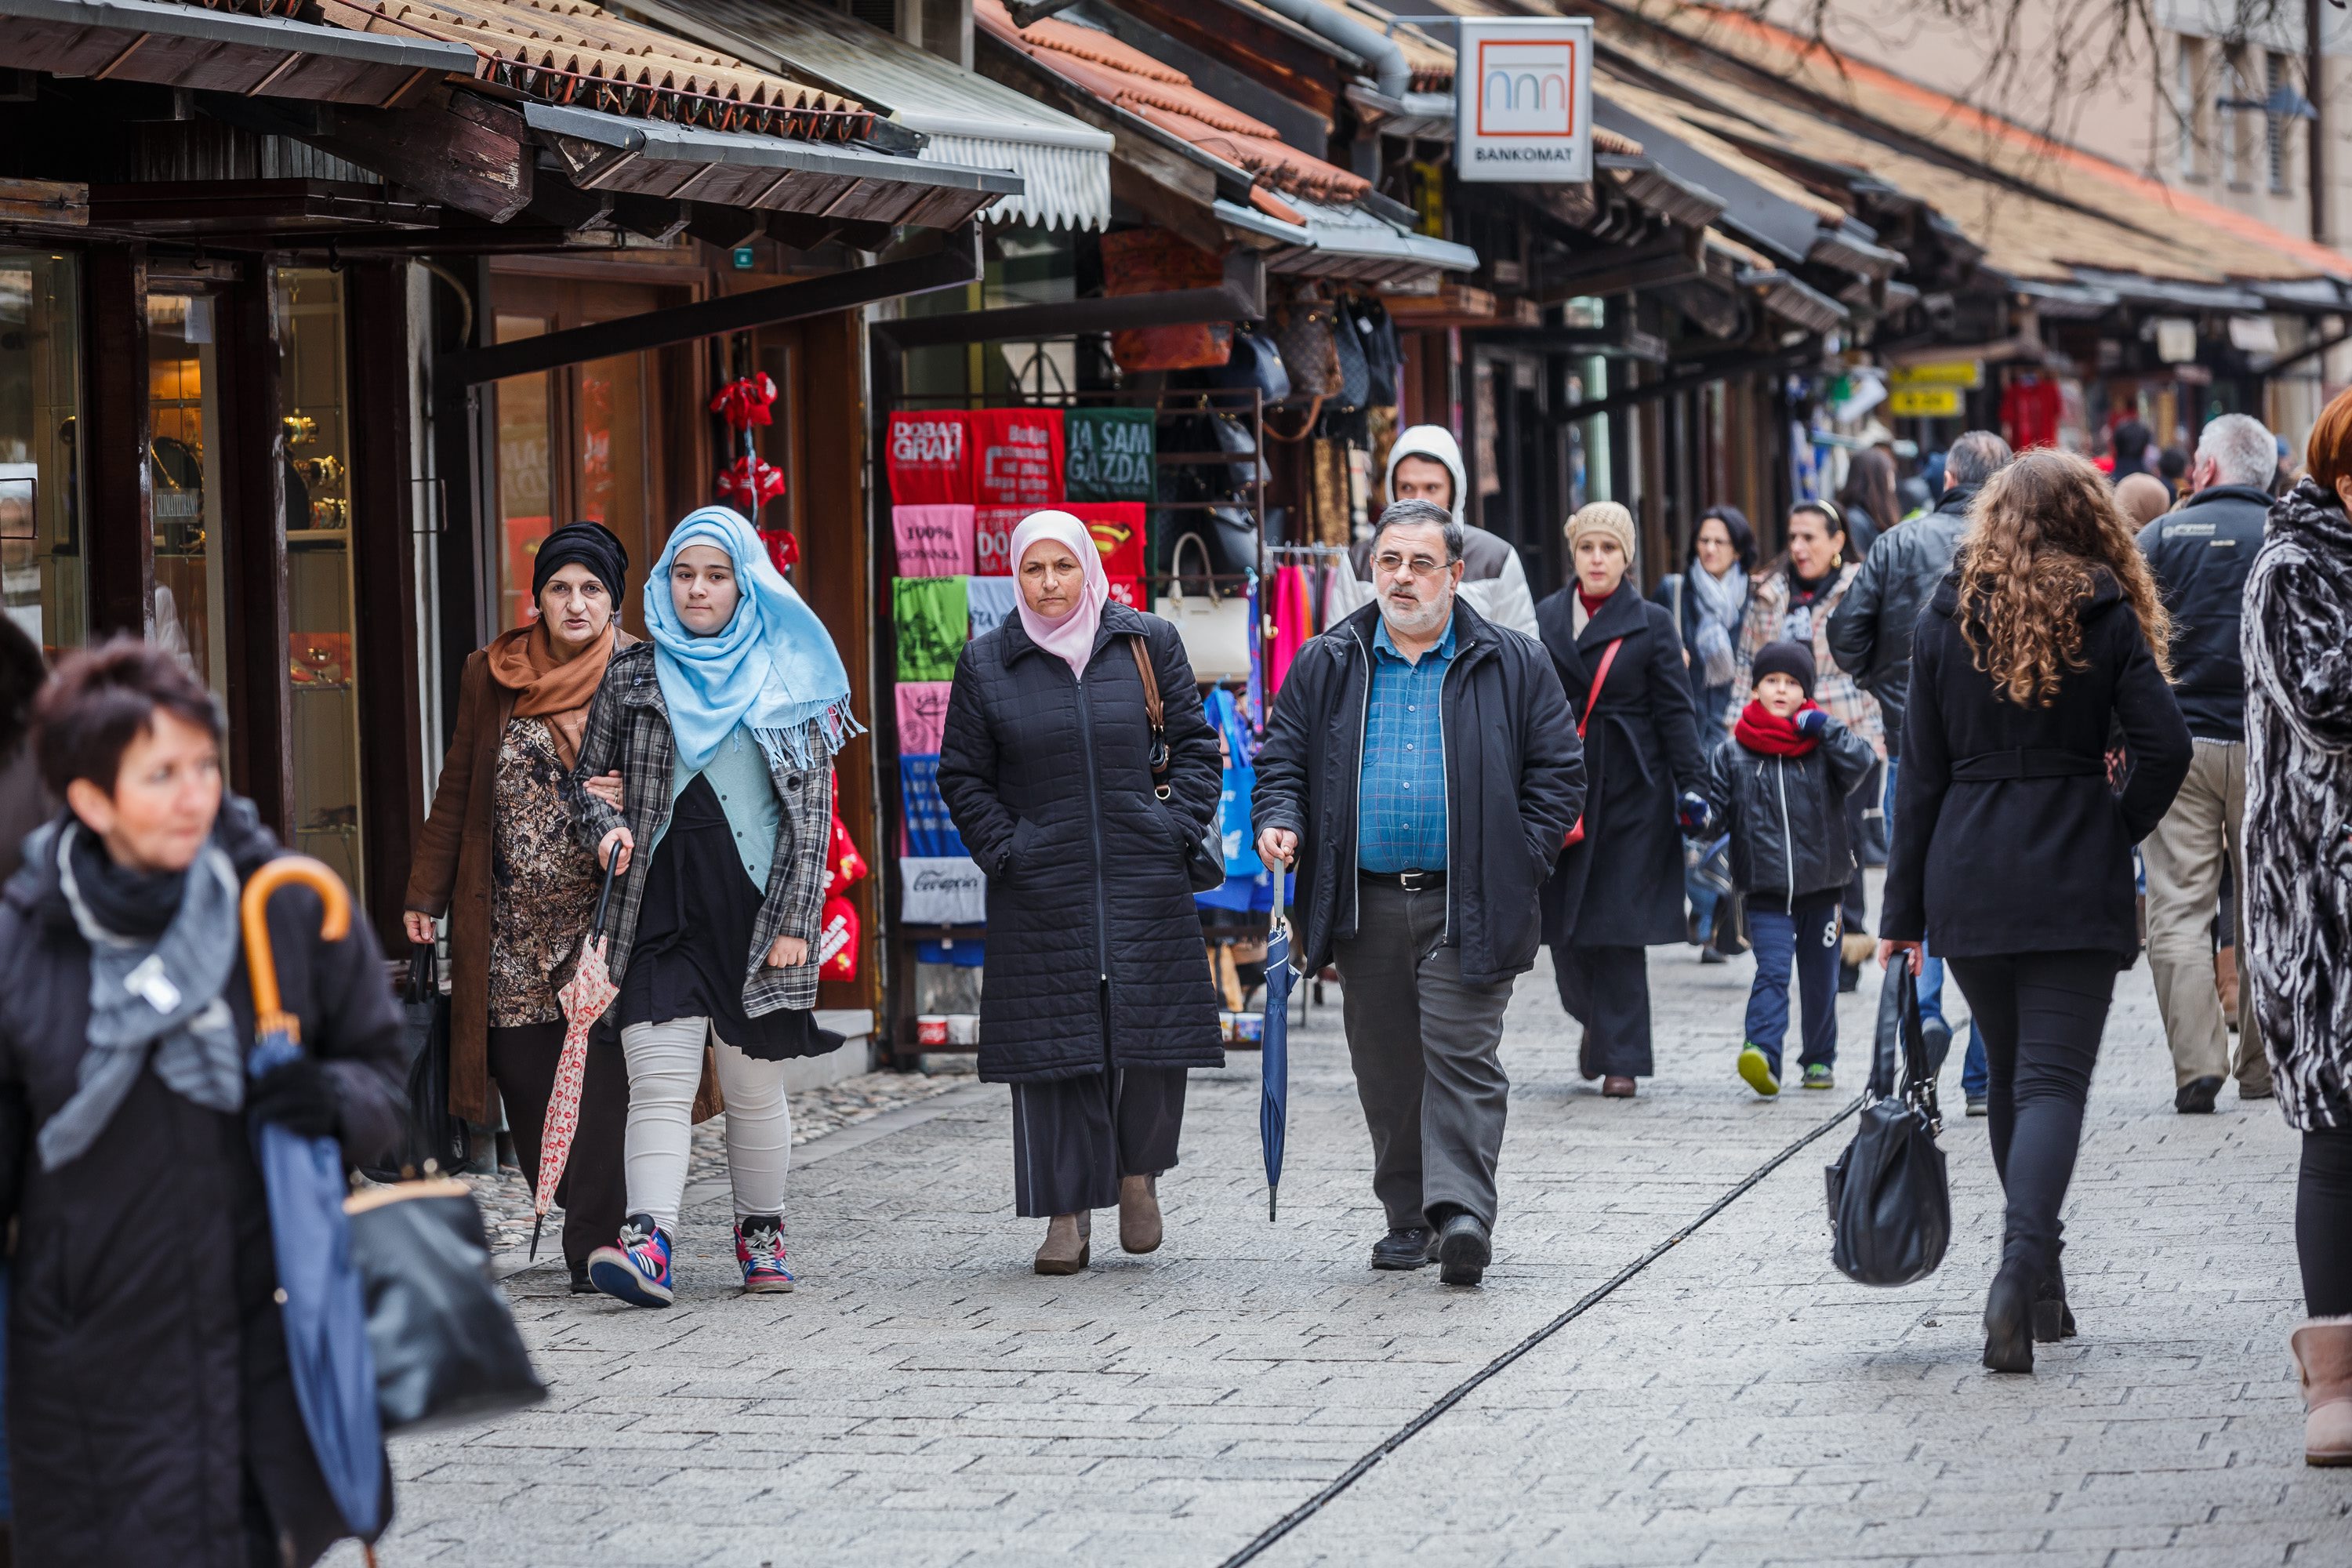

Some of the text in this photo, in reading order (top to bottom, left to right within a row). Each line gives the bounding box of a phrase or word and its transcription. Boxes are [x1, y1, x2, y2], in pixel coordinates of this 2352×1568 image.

[1475, 147, 1573, 162] BANKOMAT
[894, 421, 963, 438] DOBAR
[1101, 421, 1151, 453] SAM
[893, 437, 961, 461] GRAH
[1068, 450, 1151, 485] GAZDA
[907, 525, 953, 540] 100%
